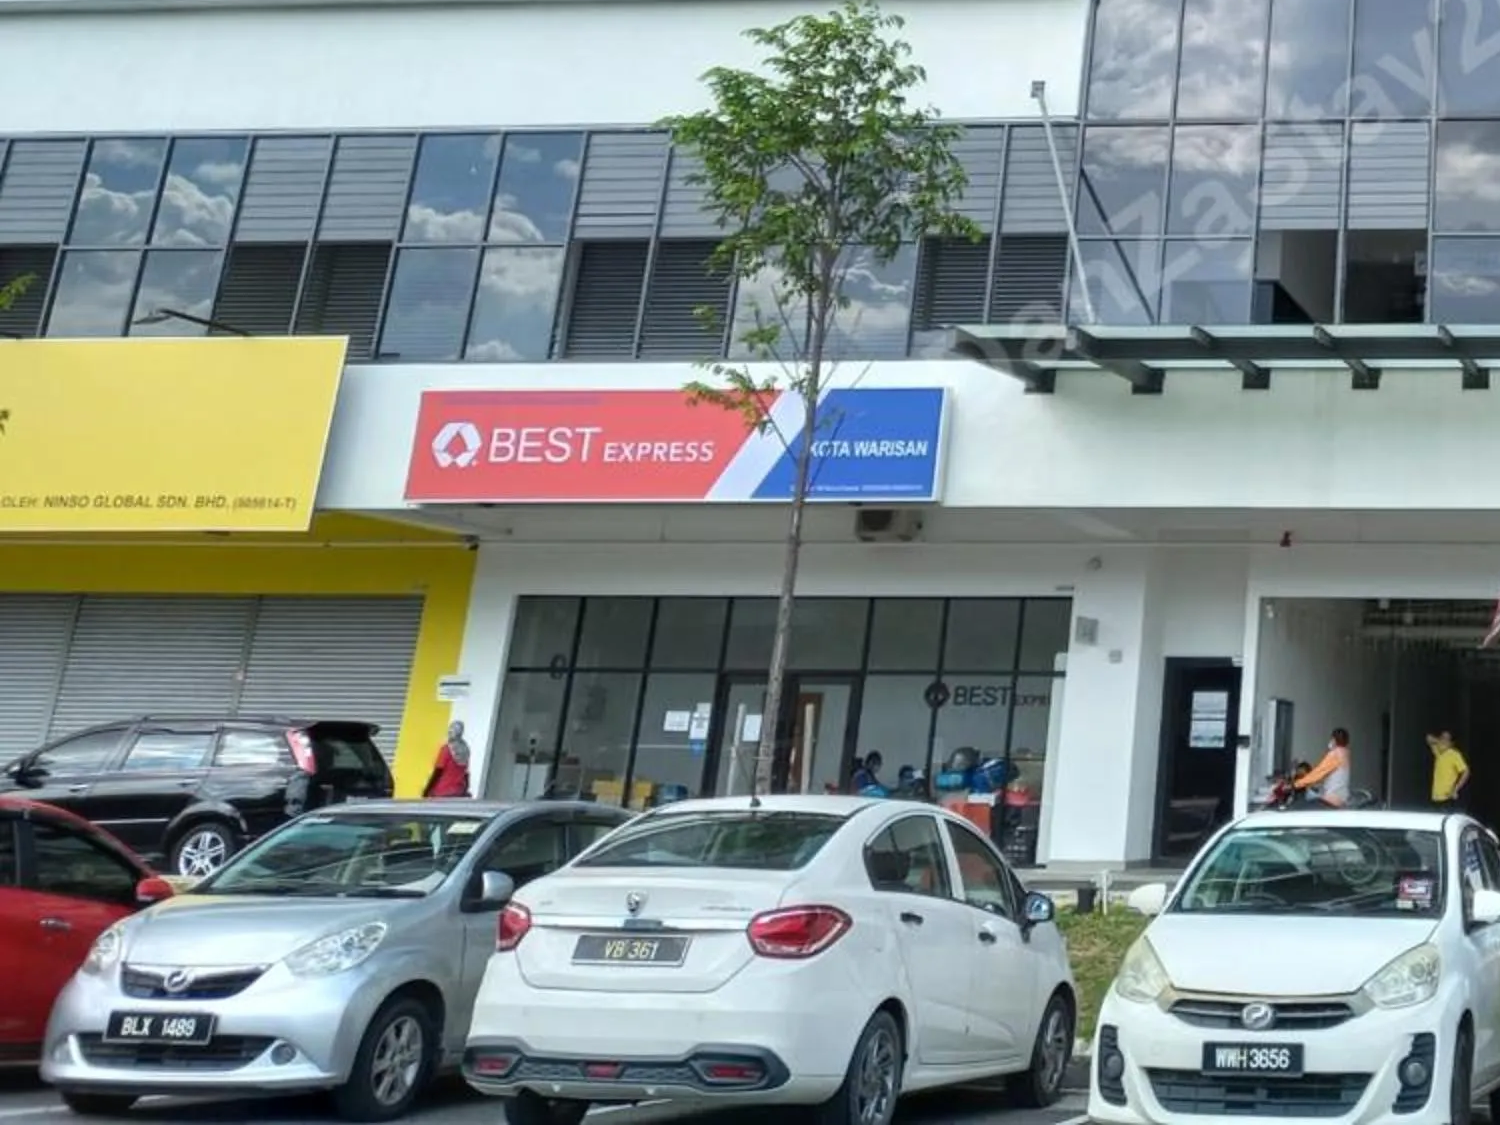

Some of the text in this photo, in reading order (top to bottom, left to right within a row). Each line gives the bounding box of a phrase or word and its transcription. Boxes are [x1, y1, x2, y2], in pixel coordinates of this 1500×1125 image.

[488, 427, 715, 463] BEST EXPRESS
[852, 439, 930, 458] WARISAN
[43, 494, 91, 508] NINSO
[92, 494, 153, 508] GLOBAL
[953, 685, 1015, 706] BEST
[120, 1015, 155, 1036] BLX
